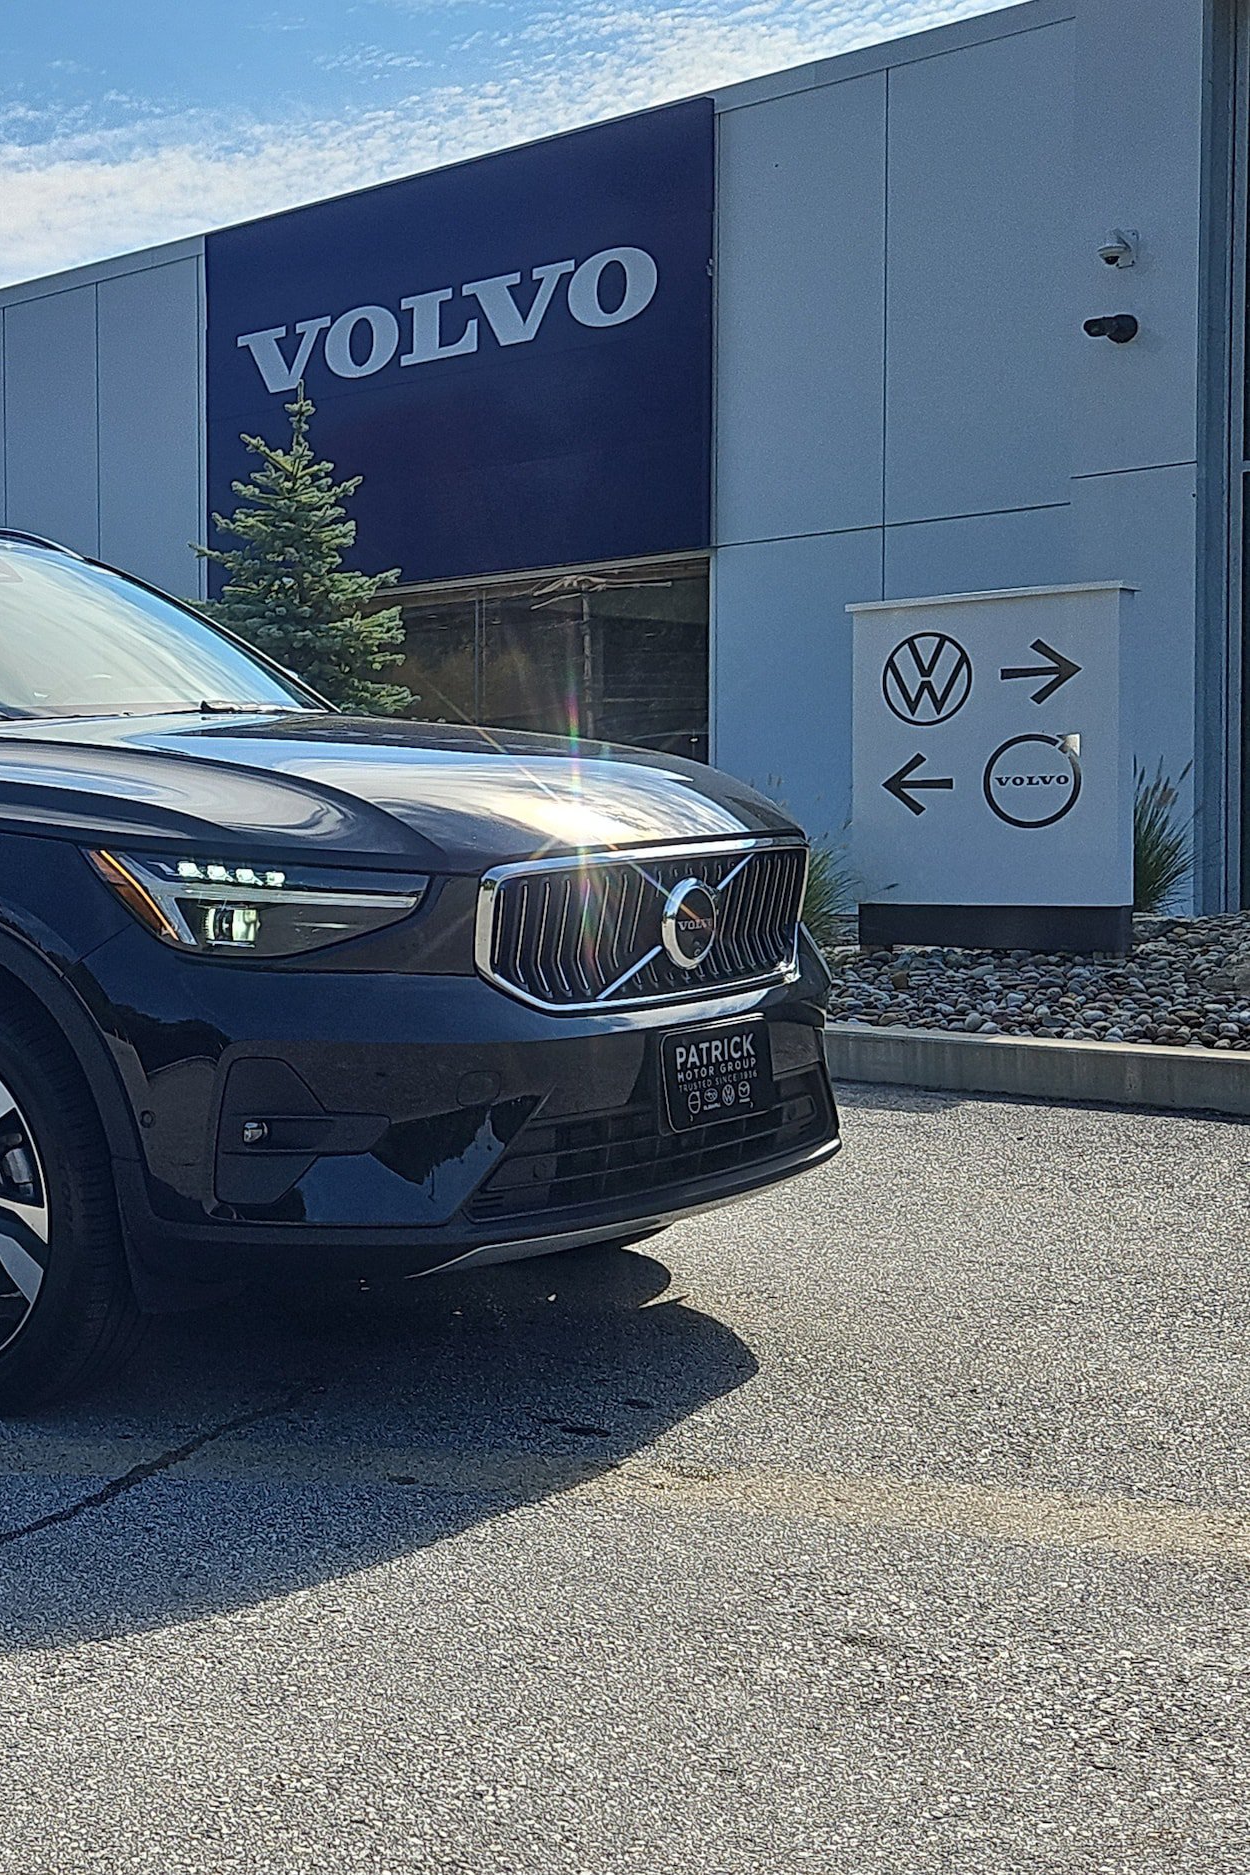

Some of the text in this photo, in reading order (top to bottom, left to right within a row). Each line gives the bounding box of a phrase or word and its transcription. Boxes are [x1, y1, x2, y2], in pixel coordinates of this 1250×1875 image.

[237, 246, 658, 394] VOLVO
[995, 773, 1070, 787] VOLVO
[675, 1033, 756, 1070] PATRICK
[677, 1057, 757, 1083] MOTOR GROUP
[679, 1079, 712, 1093] TRUSTED
[715, 1072, 738, 1085] SINCE
